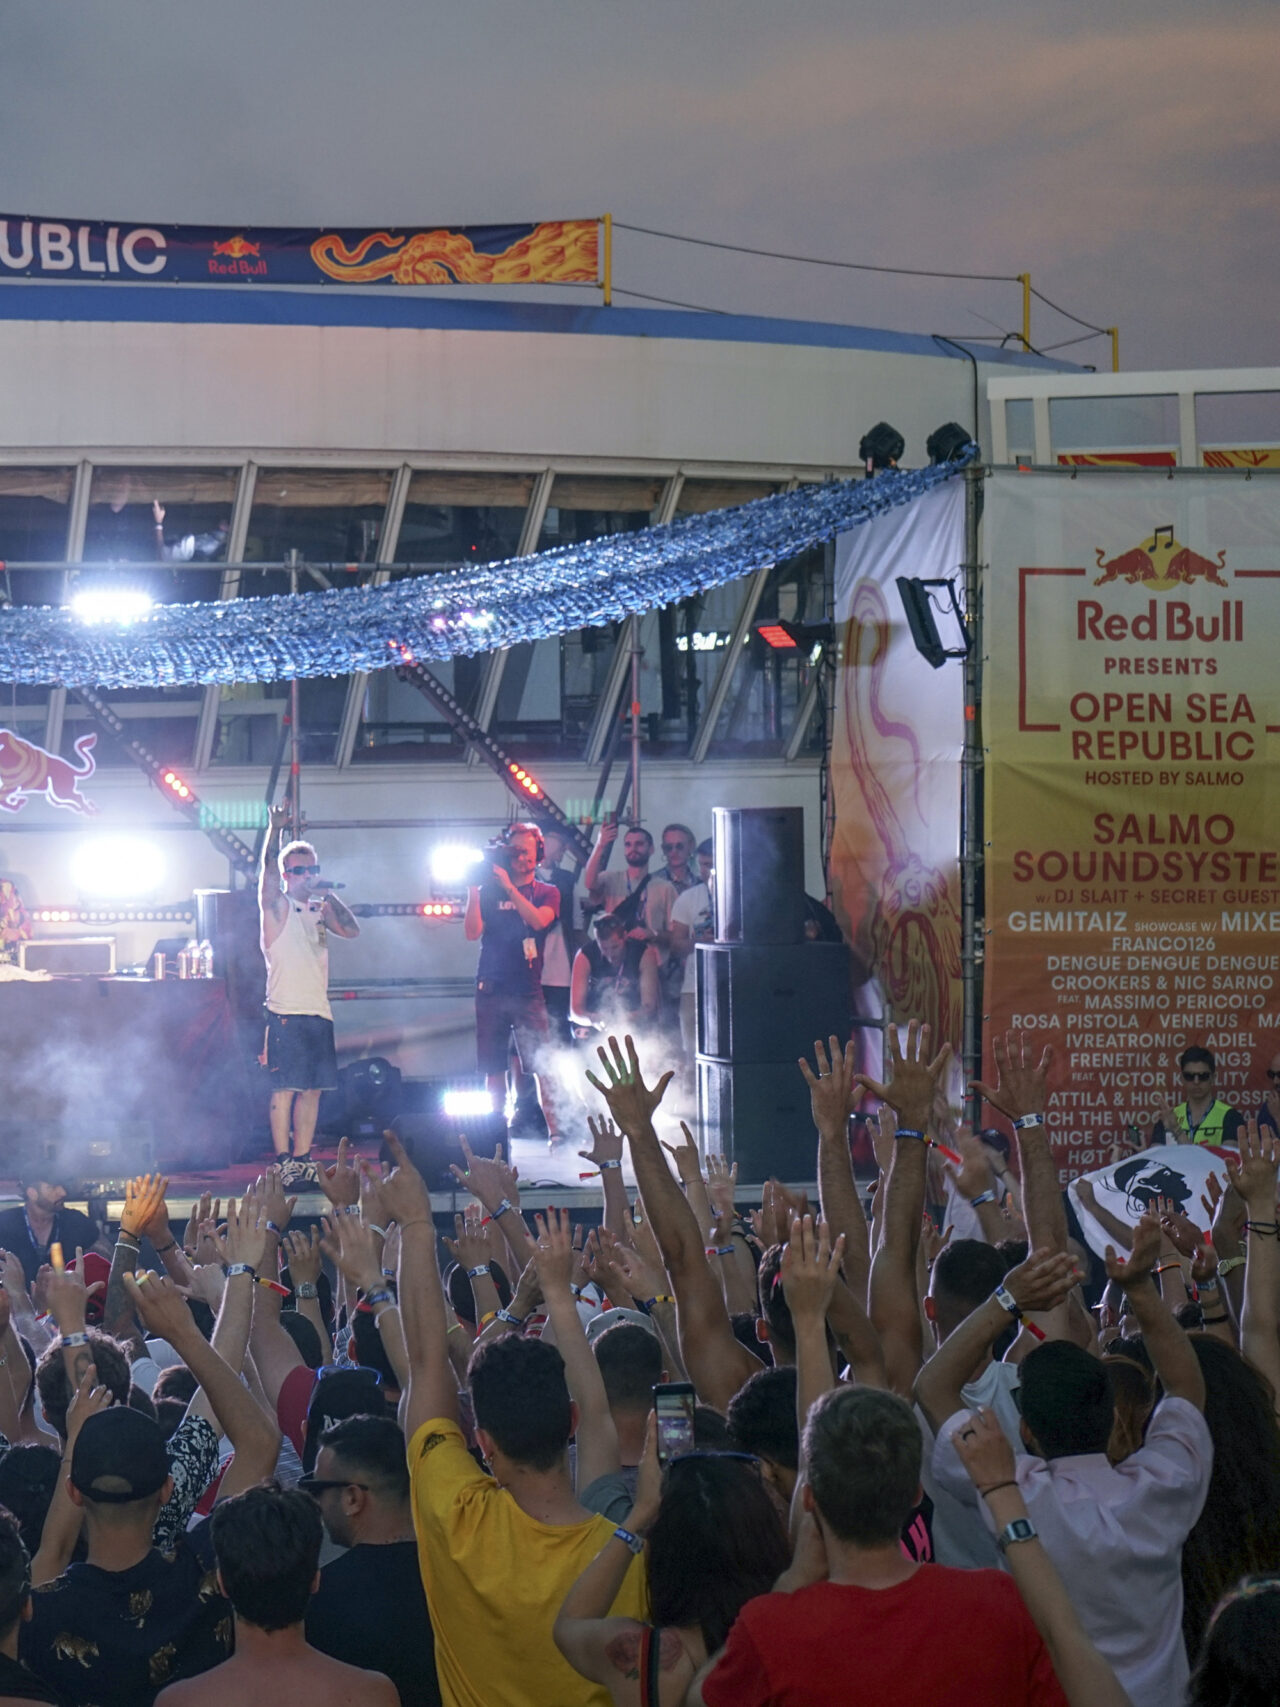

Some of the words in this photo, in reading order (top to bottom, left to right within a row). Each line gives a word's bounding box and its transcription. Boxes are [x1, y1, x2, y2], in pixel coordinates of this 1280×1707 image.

[208, 259, 236, 275] Red
[238, 259, 267, 275] Bull
[1077, 599, 1157, 641] Red
[1166, 600, 1243, 642] Bull
[1104, 657, 1218, 675] PRESENTS
[1070, 692, 1172, 723] OPEN
[1186, 693, 1256, 723] SEA
[1072, 731, 1255, 761] REPUBLIC
[1085, 771, 1153, 786] HOSTED
[1159, 771, 1181, 785] BY
[1185, 771, 1244, 786] SALMO
[1093, 813, 1235, 845] SALMO
[1013, 851, 1277, 883] SOUNDSYSTE
[1055, 889, 1073, 904] DJ
[1080, 889, 1129, 904] SLAIT
[1151, 889, 1217, 904] SECRET
[1223, 889, 1280, 904] GUEST
[1008, 911, 1128, 932] GEMITAIZ
[1134, 922, 1197, 932] SHOWCASE
[1112, 937, 1216, 951] FRANCO126
[1047, 956, 1120, 971] DENGUE
[1127, 956, 1200, 971] DENGUE
[1207, 956, 1279, 970] DENGUE
[1051, 975, 1151, 990] CROOKERS
[1157, 975, 1168, 990] &
[1174, 975, 1207, 990] NIC
[1212, 975, 1274, 990] SARNO
[1085, 995, 1170, 1009] MASSIMO
[1176, 995, 1266, 1009] PERICOLO
[1012, 1014, 1060, 1029] ROSA
[1067, 1014, 1139, 1029] PISTOLA
[1159, 1014, 1238, 1028] VENERUS
[1066, 1033, 1186, 1048] IVREATRONIC
[1205, 1033, 1257, 1047] ADIEL
[1070, 1053, 1151, 1068] FRENETIK
[1158, 1053, 1169, 1067] &
[1099, 1072, 1166, 1087] VICTOR
[1173, 1072, 1250, 1086] KLITY
[1048, 1092, 1110, 1107] ATTILA
[1113, 1091, 1125, 1106] &
[1079, 1111, 1113, 1126] THE
[1050, 1131, 1093, 1145] NICE
